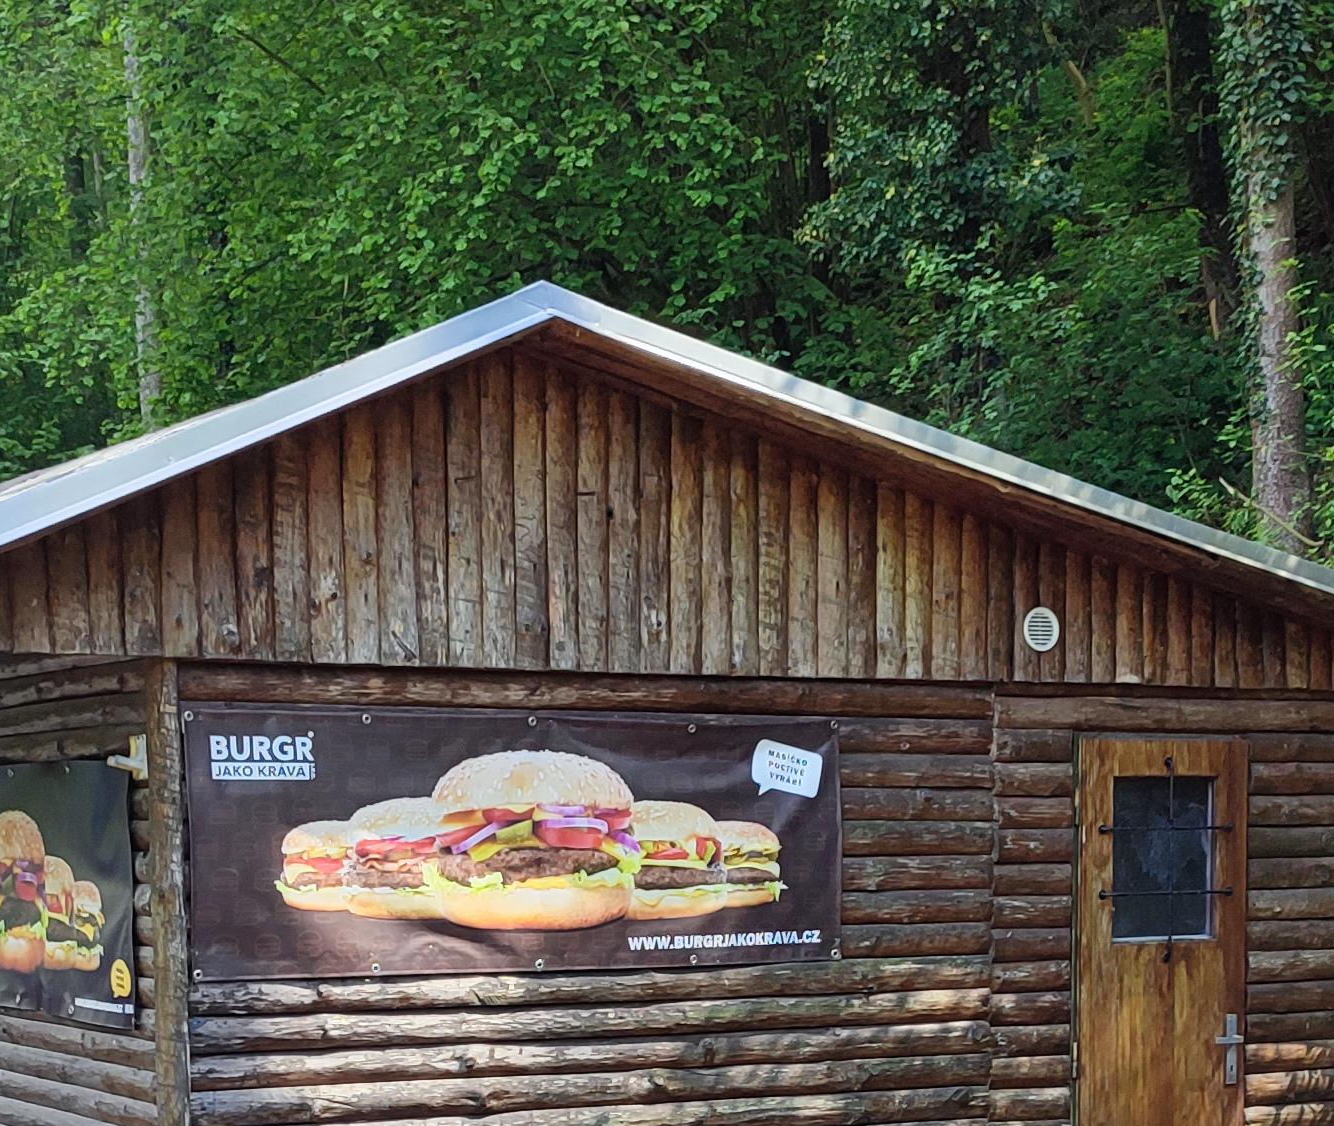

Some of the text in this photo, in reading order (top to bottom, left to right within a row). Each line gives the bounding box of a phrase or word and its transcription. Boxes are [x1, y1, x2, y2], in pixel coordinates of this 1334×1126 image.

[209, 735, 314, 761] BURGR
[215, 765, 253, 777] JAKO
[628, 930, 822, 951] WWW.BURGRJAKOKRAVA.CZ
